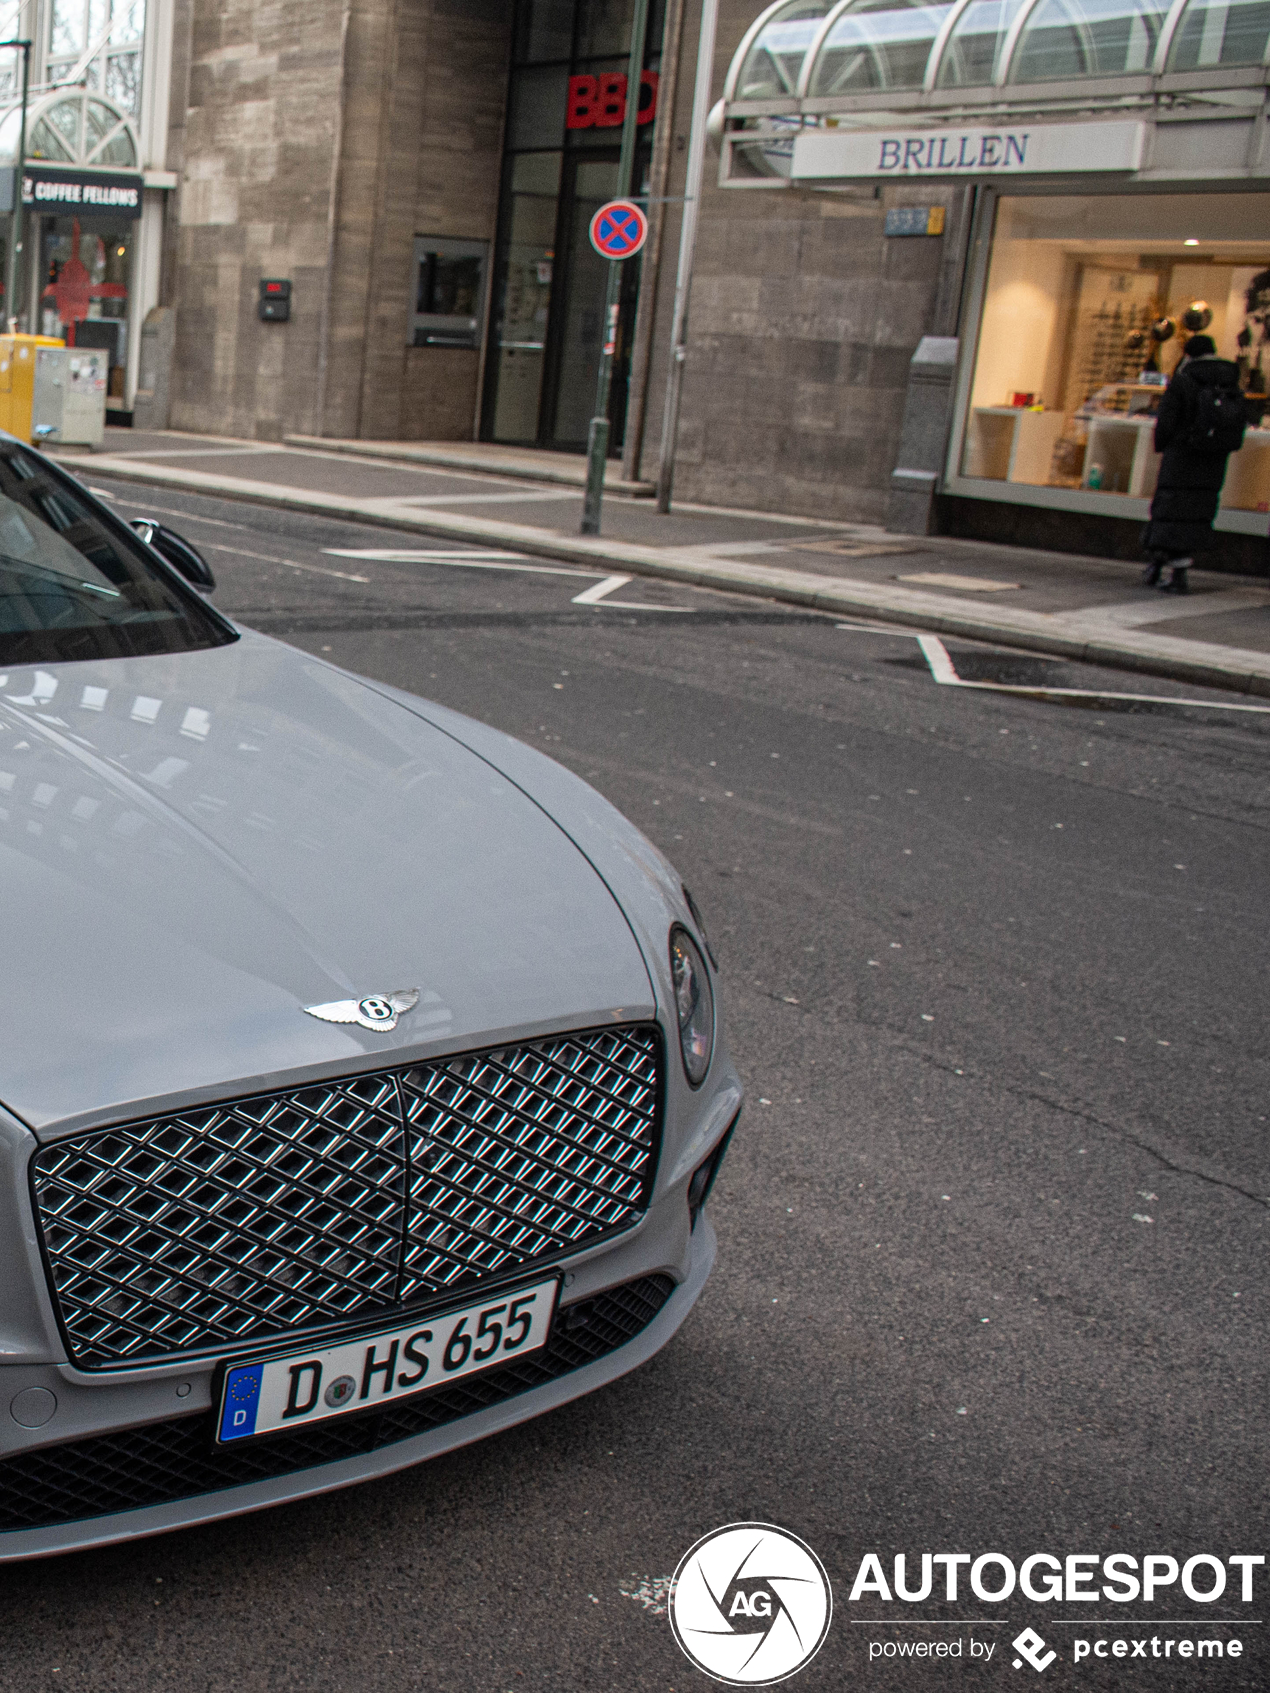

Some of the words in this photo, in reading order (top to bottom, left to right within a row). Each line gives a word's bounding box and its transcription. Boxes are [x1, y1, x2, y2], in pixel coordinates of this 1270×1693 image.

[878, 134, 1029, 170] BRILLEN
[35, 181, 82, 203] COFFEE
[82, 185, 138, 207] FELLOWS
[282, 1360, 323, 1419] D
[359, 1329, 433, 1400] HS
[442, 1293, 537, 1372] 655
[233, 1410, 247, 1426] D
